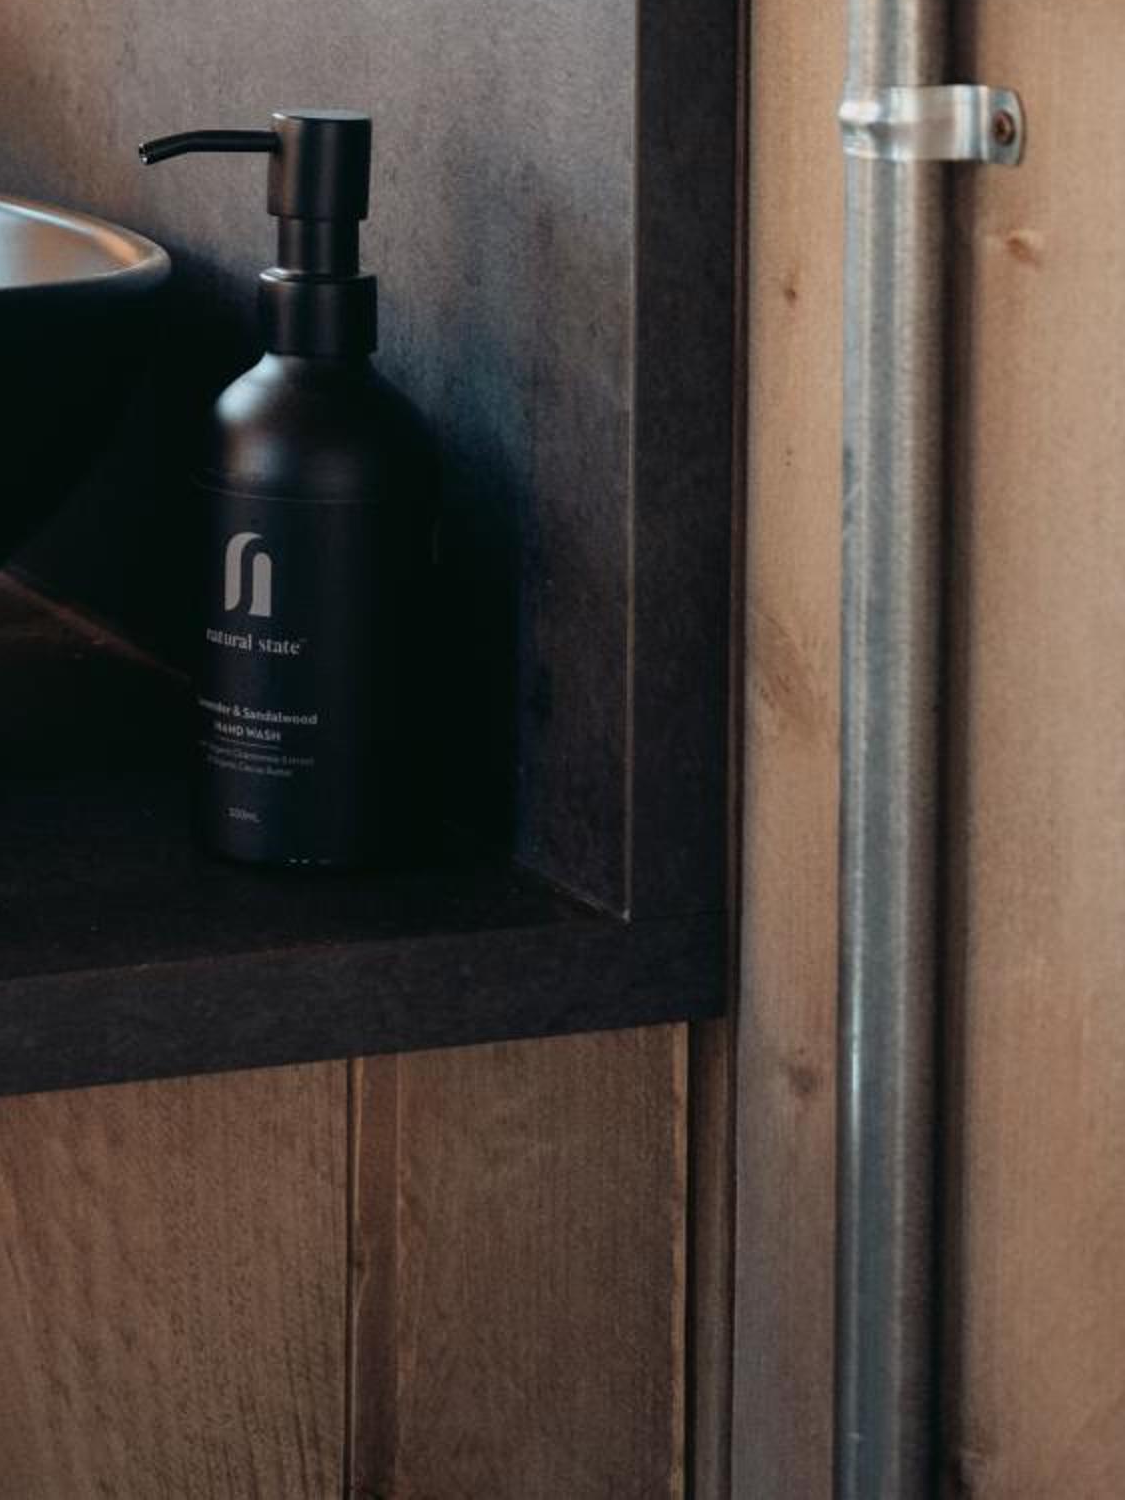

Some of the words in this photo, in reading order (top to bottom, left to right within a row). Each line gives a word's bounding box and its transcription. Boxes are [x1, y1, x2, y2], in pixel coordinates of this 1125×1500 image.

[258, 638, 300, 655] state
[242, 706, 318, 725] Sandalwood
[246, 726, 281, 741] WASH
